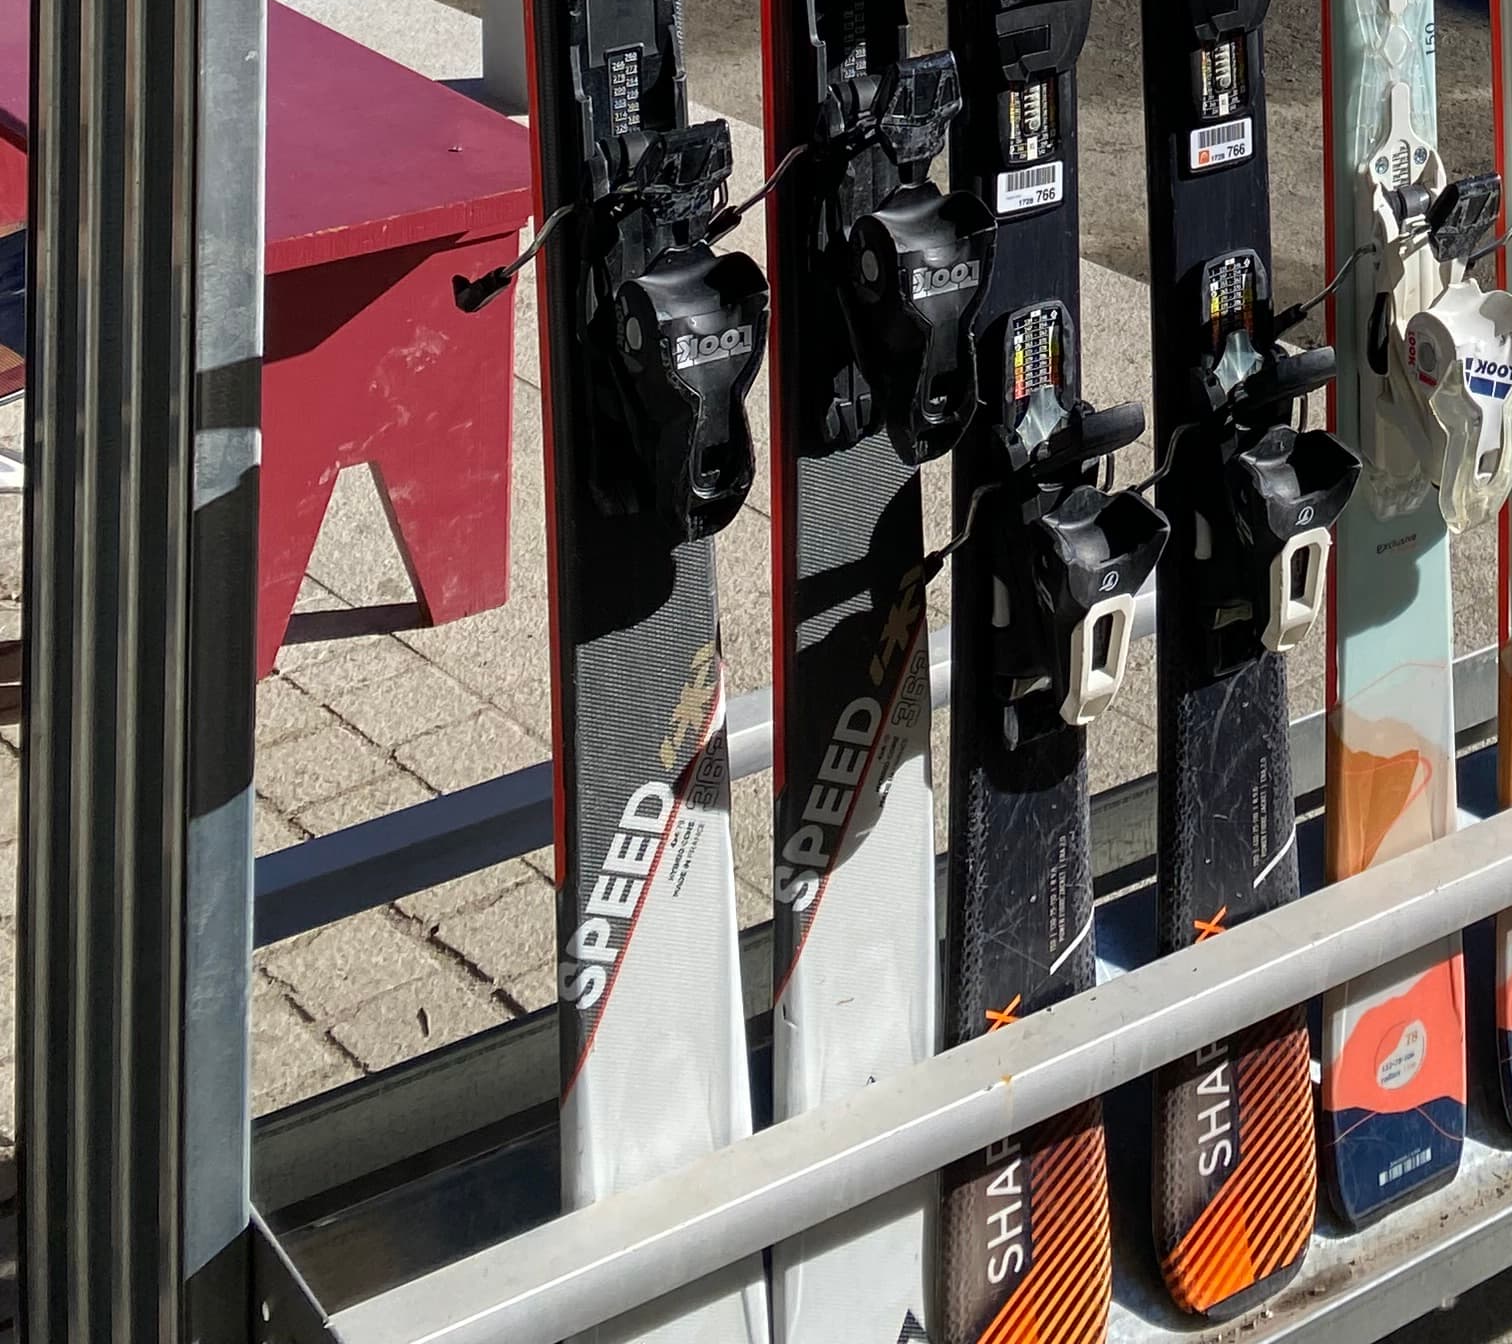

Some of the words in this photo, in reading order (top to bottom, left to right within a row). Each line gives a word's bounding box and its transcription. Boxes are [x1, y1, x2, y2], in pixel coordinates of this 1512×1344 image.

[1227, 143, 1245, 158] 766
[1035, 187, 1056, 203] 766
[912, 260, 979, 293] LOOK
[676, 324, 752, 363] LOOK
[1407, 330, 1416, 368] LOOK
[1376, 533, 1417, 554] exclusive
[775, 695, 883, 914] SPEED
[562, 780, 674, 1012] SPEED
[1405, 1029, 1419, 1046] 78
[1196, 1040, 1232, 1177] SHAP
[986, 1137, 1023, 1285] SHAP
